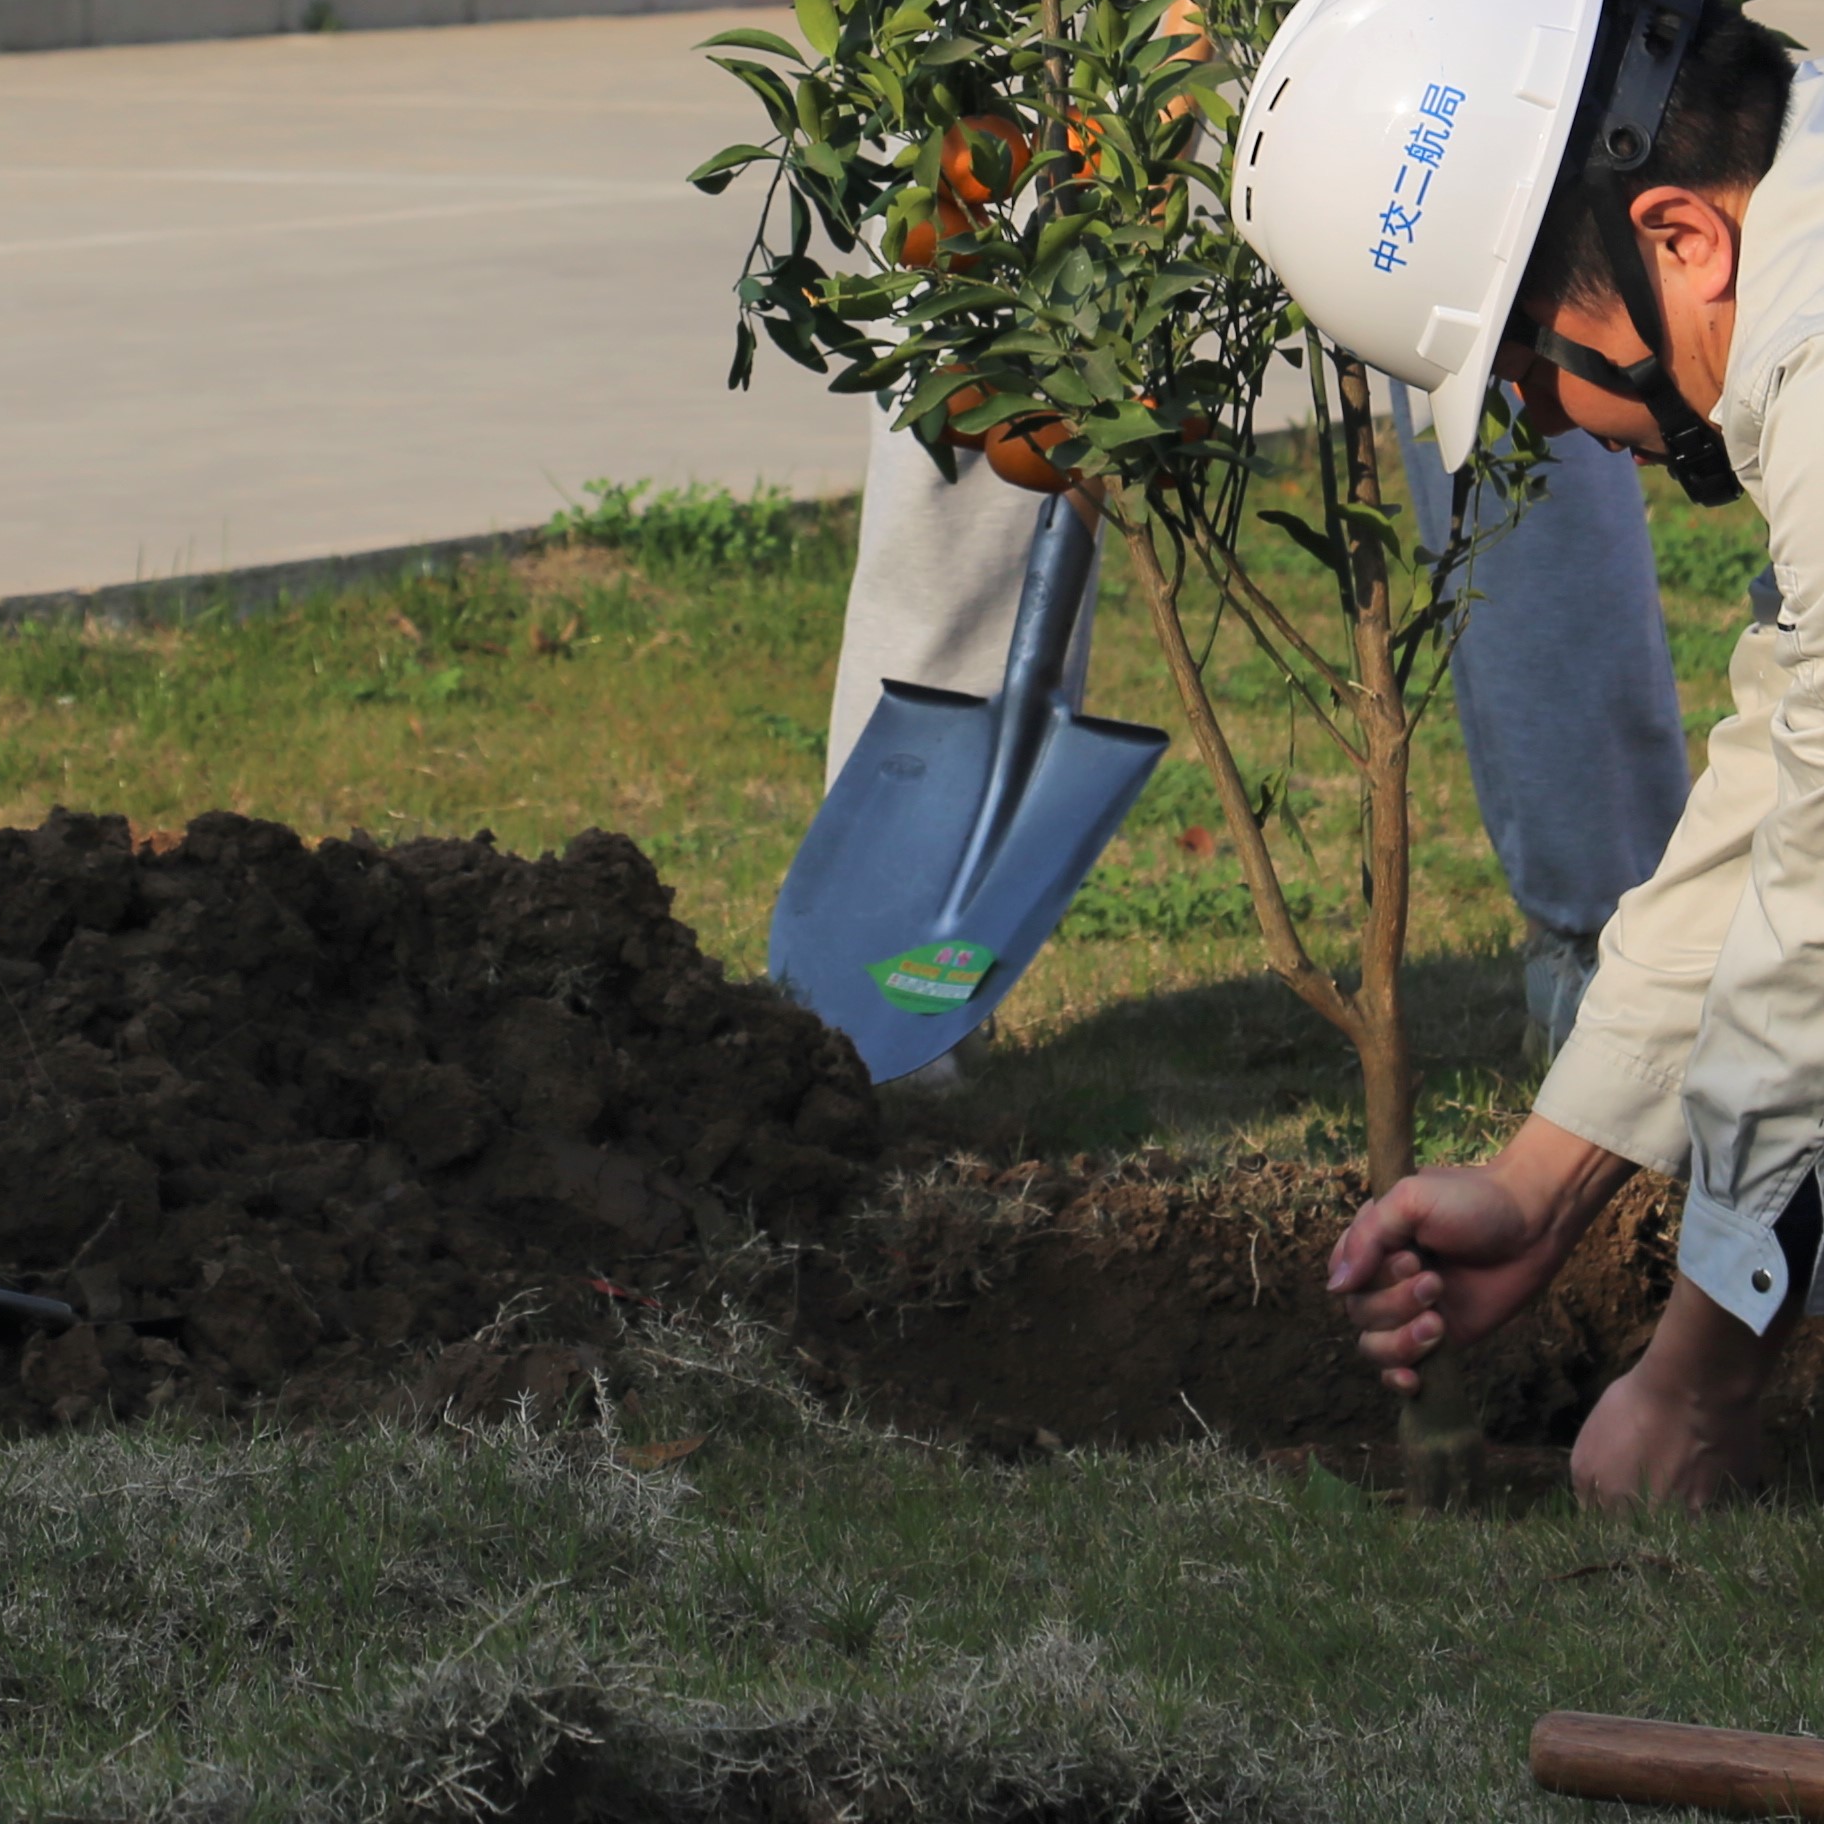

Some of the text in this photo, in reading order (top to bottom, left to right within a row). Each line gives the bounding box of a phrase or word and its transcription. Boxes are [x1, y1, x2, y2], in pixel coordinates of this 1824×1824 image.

[1368, 82, 1467, 274] 中交二航局
